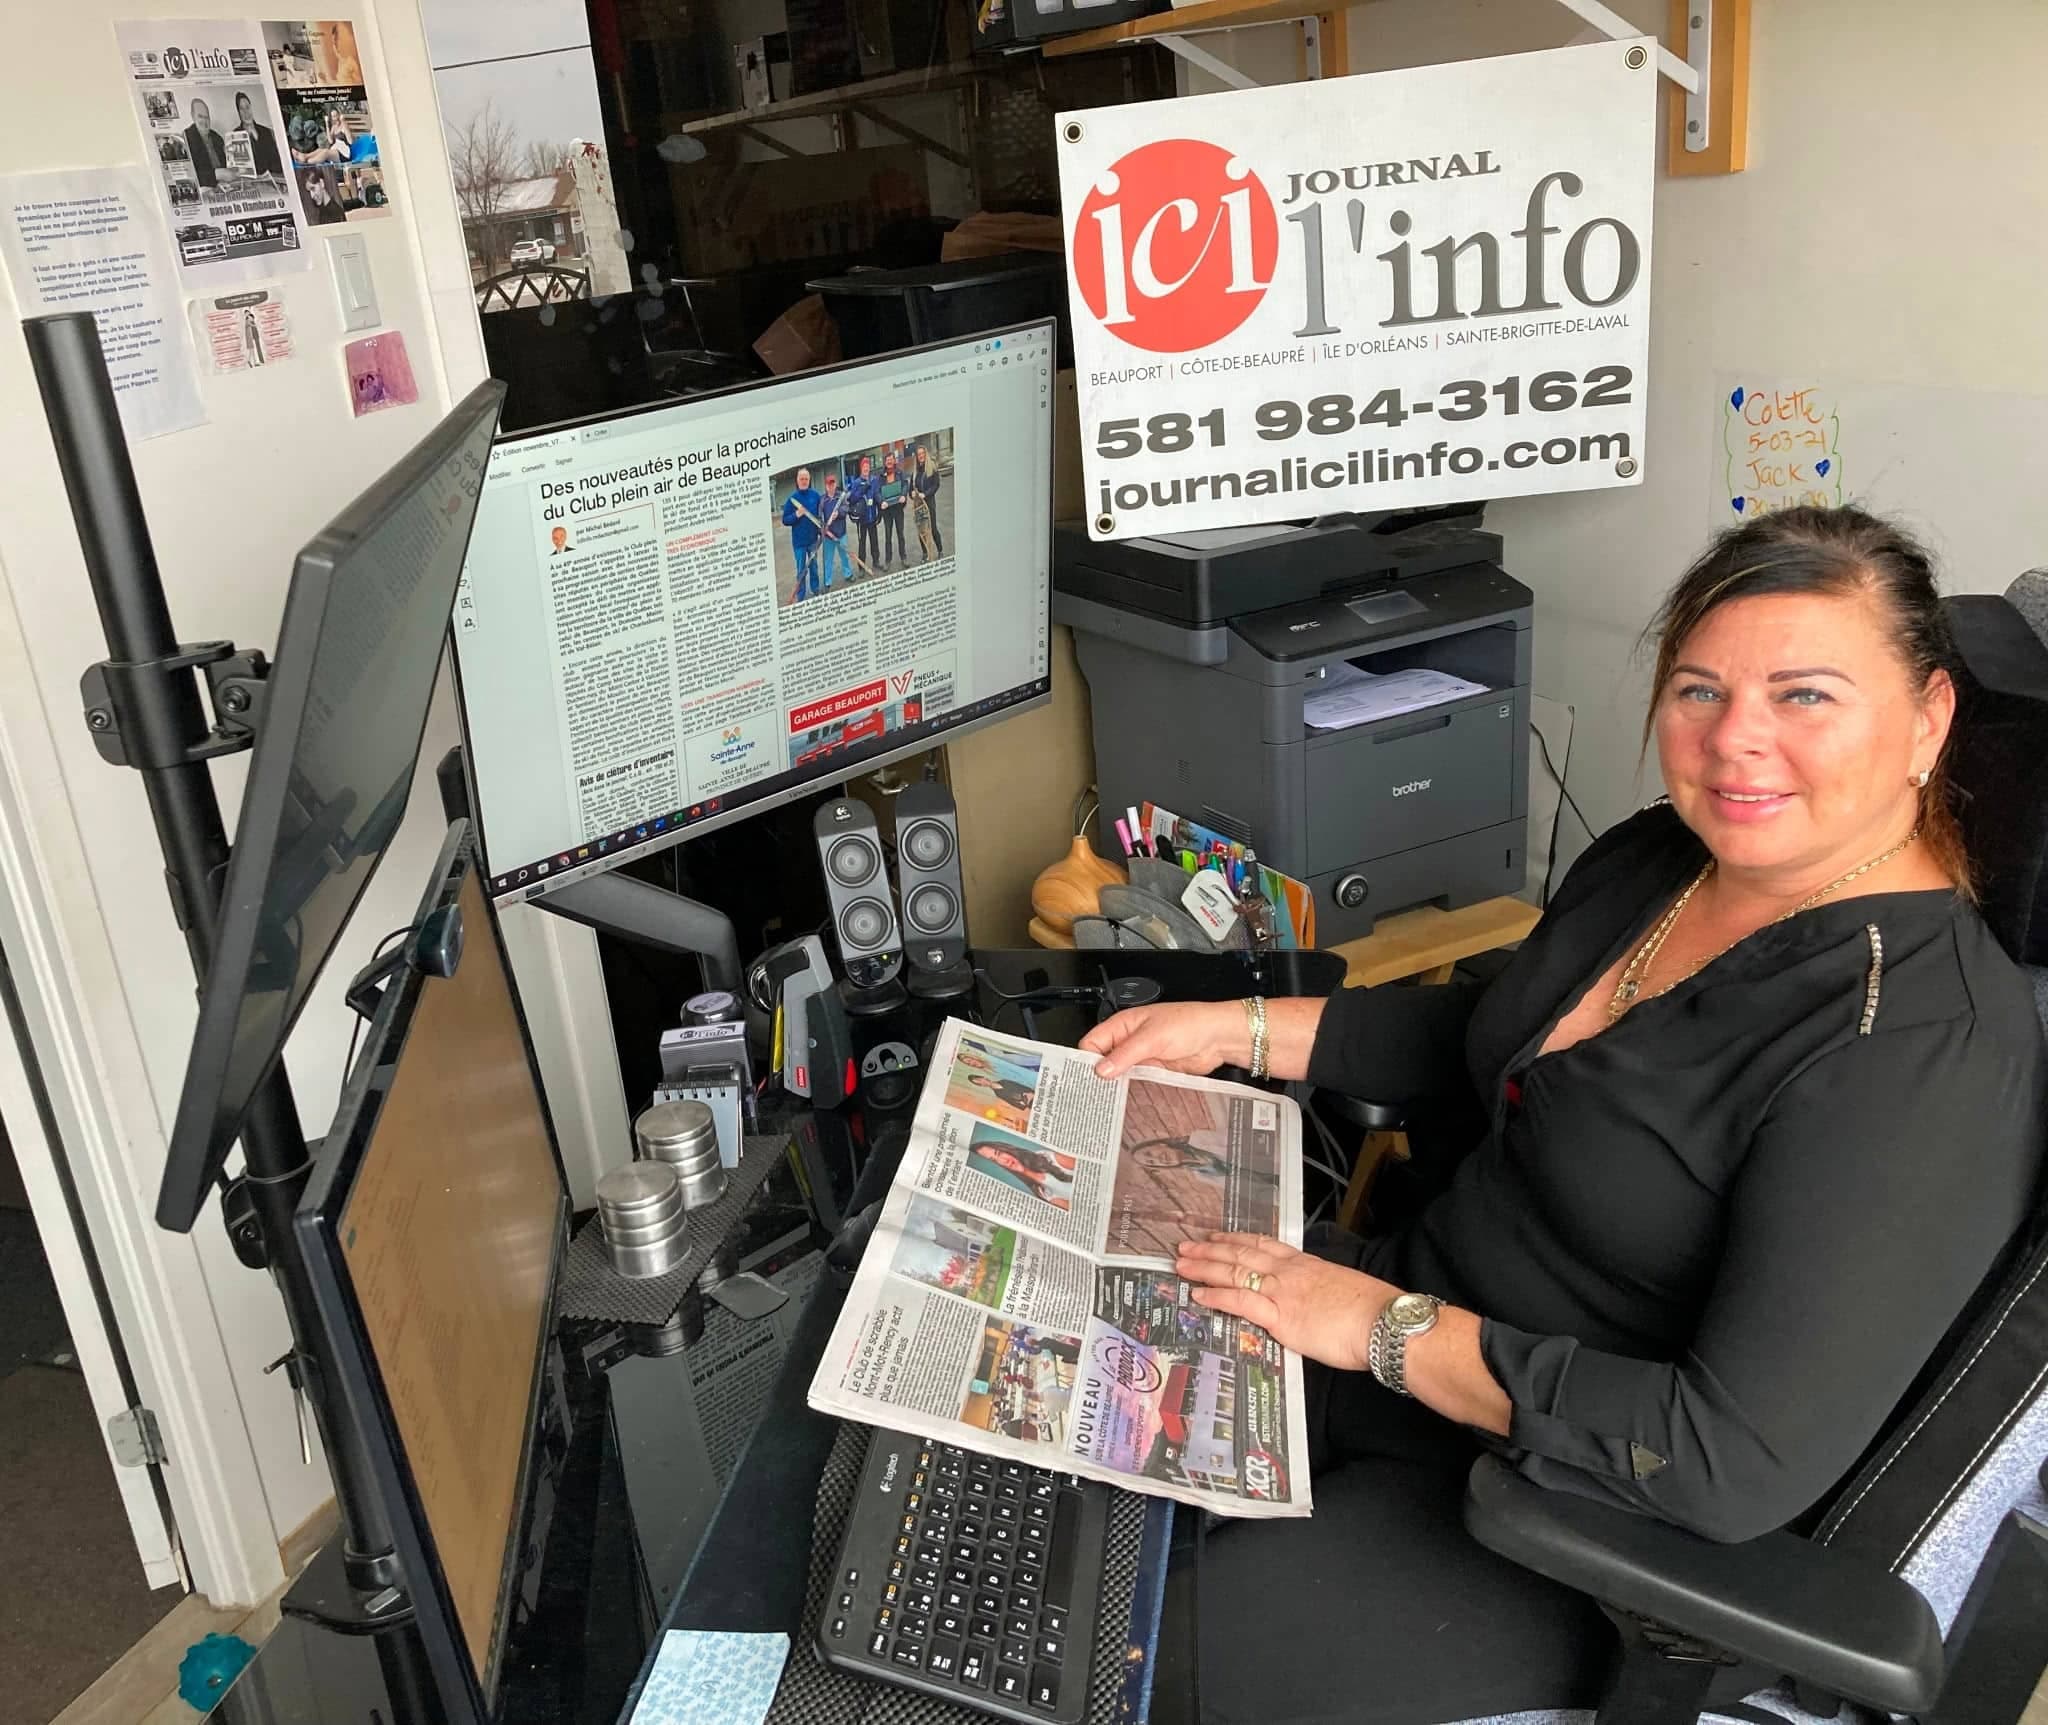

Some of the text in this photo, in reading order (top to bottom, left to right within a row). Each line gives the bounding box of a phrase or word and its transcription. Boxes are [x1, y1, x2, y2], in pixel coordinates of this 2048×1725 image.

[1282, 150, 1501, 204] JOURNAL
[1090, 158, 1641, 337] ici l'info
[1090, 314, 1630, 386] BEAUPORT CÔTE-DE-BEAUPRÉ ÎLE D'ORLÉANS SAINTE-BRIGITTE-DE-LAVAL
[1096, 364, 1633, 459] 581 984-3162
[540, 411, 855, 500] Des nouveautés pour la prochaine saison
[1098, 430, 1631, 514] journalicilinfo.com
[542, 451, 770, 521] du Club plein air de Beauport
[913, 670, 934, 683] PNEUS
[914, 669, 952, 691] MÉCANIQUE
[793, 685, 882, 726] GARAGE BEAUPORT
[710, 739, 754, 762] Sainte-Anne
[1392, 778, 1432, 797] brother
[944, 1185, 954, 1196] de
[1117, 1211, 1131, 1248] POURQUOI
[888, 1305, 904, 1325] actif
[1002, 1302, 1014, 1314] La
[847, 1307, 888, 1392] Le Club de scrabble
[878, 1335, 909, 1402] plus que jamais
[1115, 1336, 1137, 1391] PADDOCK
[1073, 1376, 1101, 1457] NOUVEAU
[886, 1452, 899, 1483] Logitech
[1095, 1446, 1104, 1462] SUR
[1245, 1453, 1270, 1498] XCR
[944, 1482, 983, 1629] Q W E R T Y U
[983, 1466, 1018, 1608] S D F G J K
[1015, 1550, 1036, 1631] Z X C V
